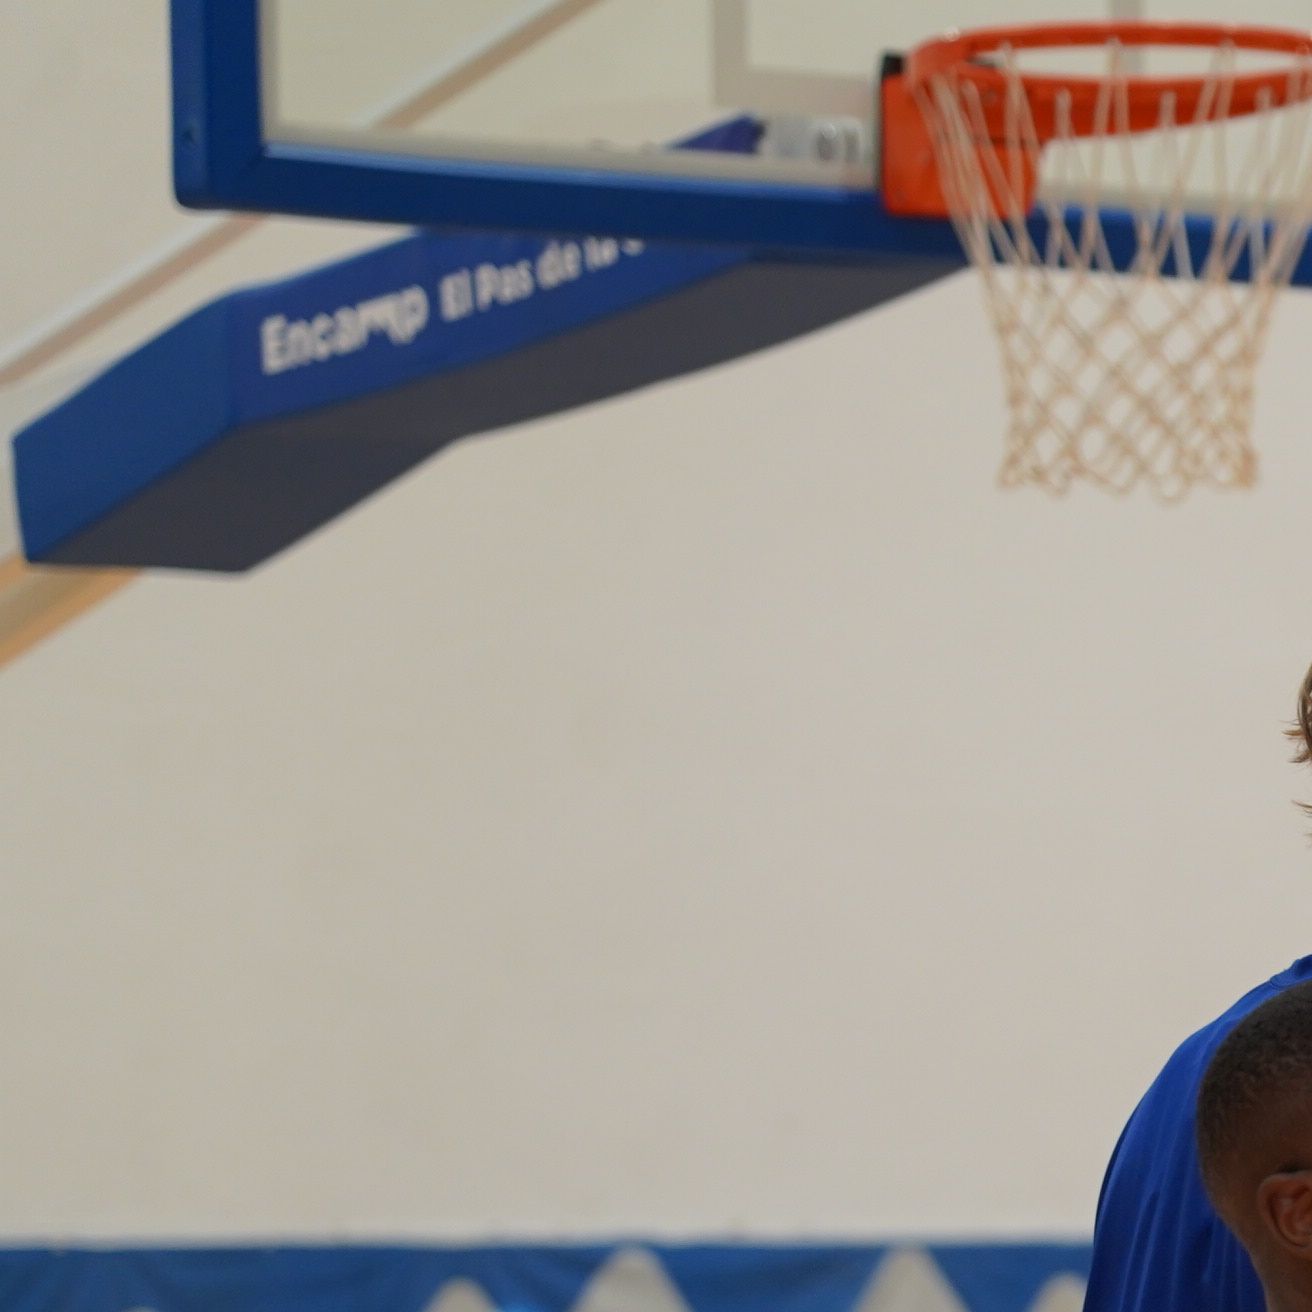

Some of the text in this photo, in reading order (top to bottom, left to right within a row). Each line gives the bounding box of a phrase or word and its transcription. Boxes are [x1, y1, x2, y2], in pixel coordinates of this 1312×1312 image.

[262, 286, 428, 374] Encamp
[440, 271, 474, 321] El
[475, 263, 536, 312] Pas
[536, 241, 581, 289] de
